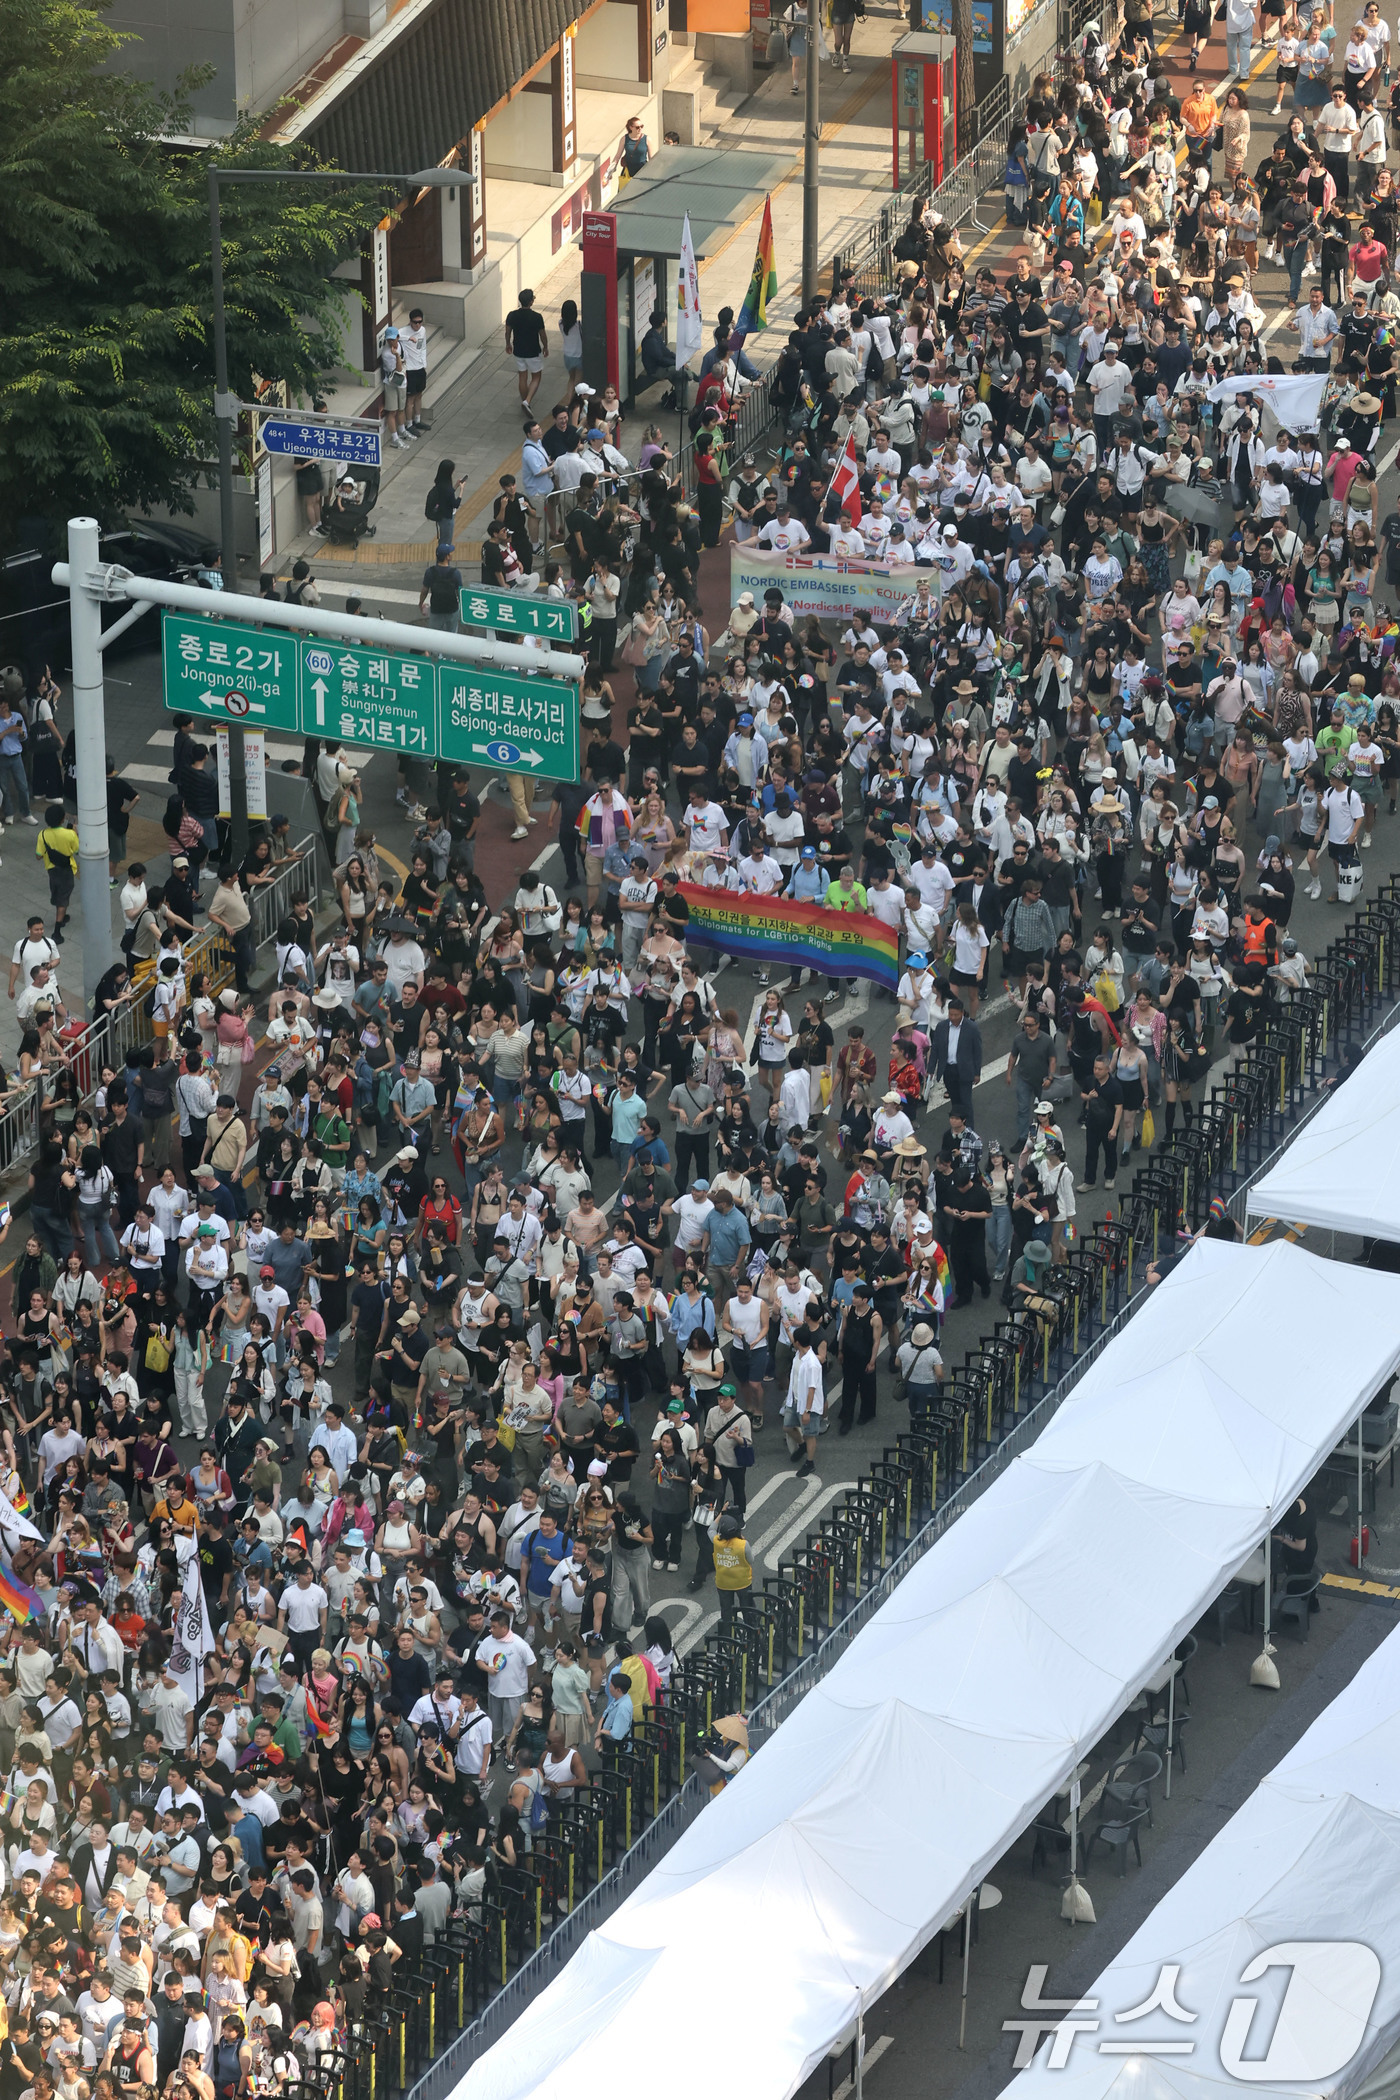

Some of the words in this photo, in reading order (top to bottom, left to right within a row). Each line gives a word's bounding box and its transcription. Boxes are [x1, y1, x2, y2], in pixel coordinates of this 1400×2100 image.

[585, 231, 597, 239] City
[268, 429, 277, 437] 48
[298, 428, 377, 451] 우정국로2길
[283, 442, 352, 459] Ujeongguk-ro
[354, 451, 377, 462] 2-gil
[740, 575, 788, 589] NORDIC
[790, 580, 856, 595] EMBASSIES
[858, 584, 875, 596] for
[178, 633, 282, 677] 종로2가
[311, 655, 328, 670] 60
[181, 664, 234, 687] Jongno
[236, 674, 281, 698] 2(i)-ga
[341, 694, 418, 719] Sungnyemun
[451, 685, 565, 728] 세종대로사거리
[338, 712, 428, 751] 을지로1가
[451, 709, 542, 741] Sejong-daero
[543, 728, 565, 745] Jct
[497, 744, 510, 761] 6
[690, 905, 712, 919] 수자
[718, 910, 751, 925] 인권을
[757, 917, 800, 933] 지지하는
[806, 924, 834, 941] 외교관
[840, 931, 864, 945] 모임
[697, 917, 743, 935] Diplomats
[746, 927, 760, 937] for
[808, 936, 832, 952] Rights
[717, 1560, 739, 1568] MEDIA
